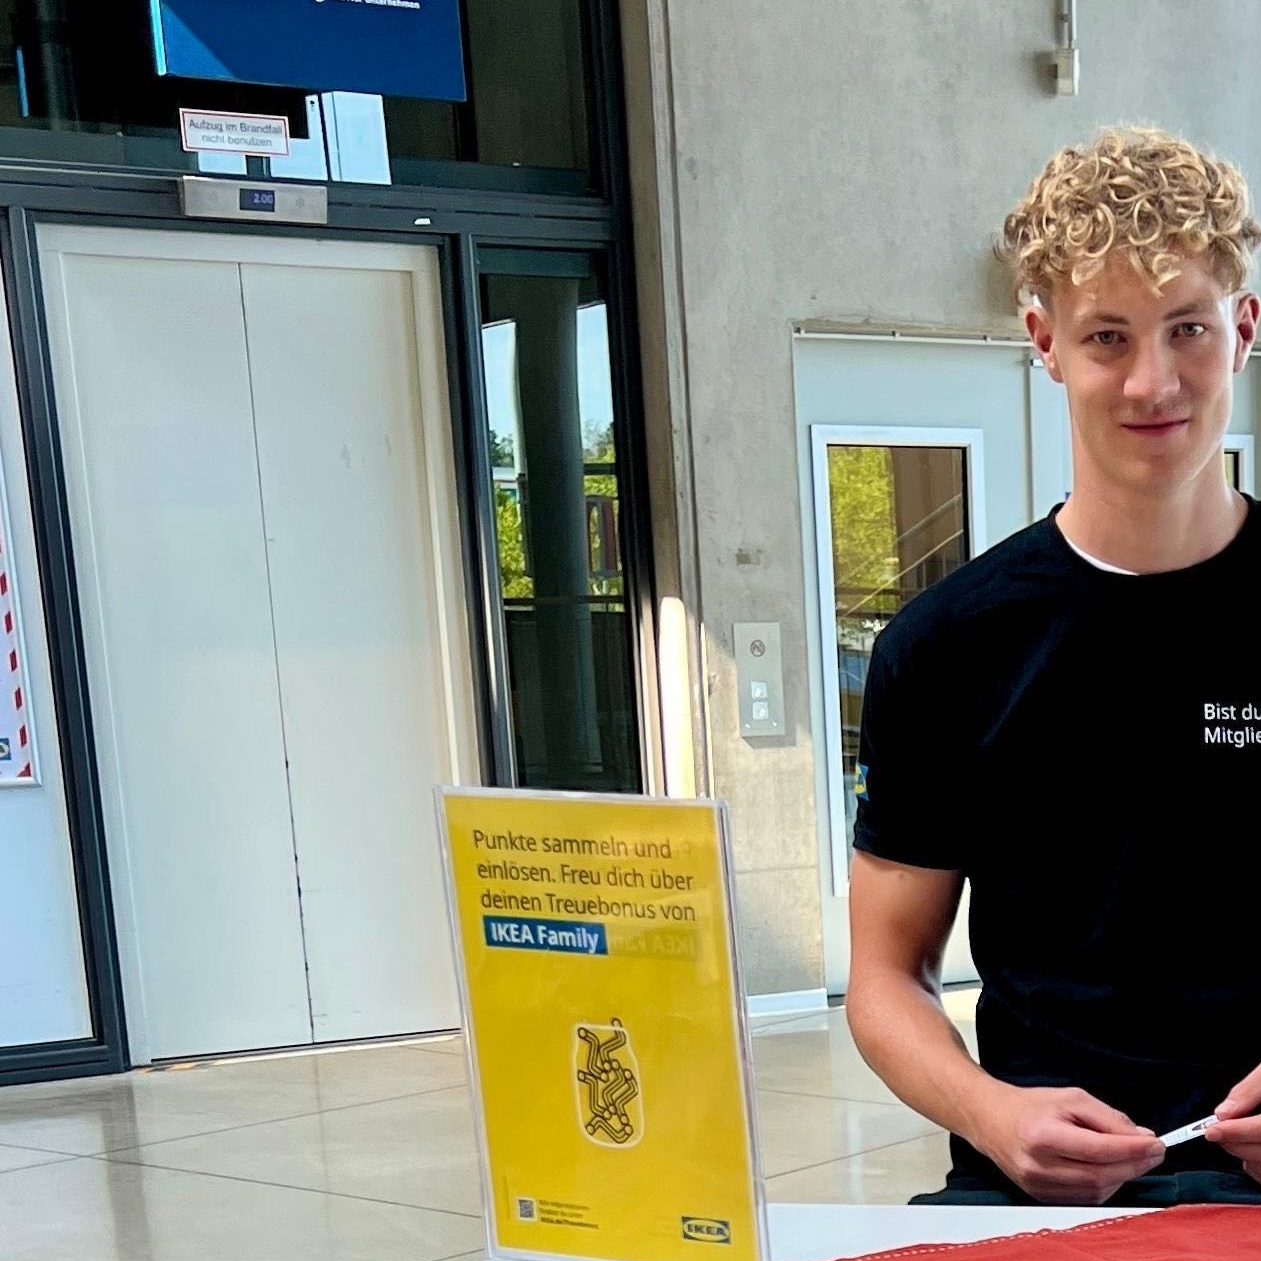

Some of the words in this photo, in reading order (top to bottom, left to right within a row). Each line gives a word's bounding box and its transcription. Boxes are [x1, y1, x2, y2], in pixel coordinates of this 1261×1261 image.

[189, 119, 223, 133] Aufzug
[225, 122, 237, 131] im
[239, 122, 283, 134] Brandfall
[202, 134, 224, 144] nicht
[227, 136, 272, 147] benutzen
[253, 193, 274, 204] 2.00
[1204, 702, 1237, 720] Bist
[473, 829, 537, 852] Punkte
[542, 836, 628, 857] sammeln
[635, 838, 672, 858] und
[477, 861, 556, 883] einlösen.
[561, 864, 601, 885] Freu
[606, 866, 645, 888] dich
[650, 870, 694, 890] über
[481, 889, 542, 912] deinen
[546, 893, 656, 919] Treuebonus
[660, 904, 696, 921] von
[490, 922, 534, 944] IKEA
[538, 925, 600, 954] Family
[687, 1223, 728, 1237] IKEA
